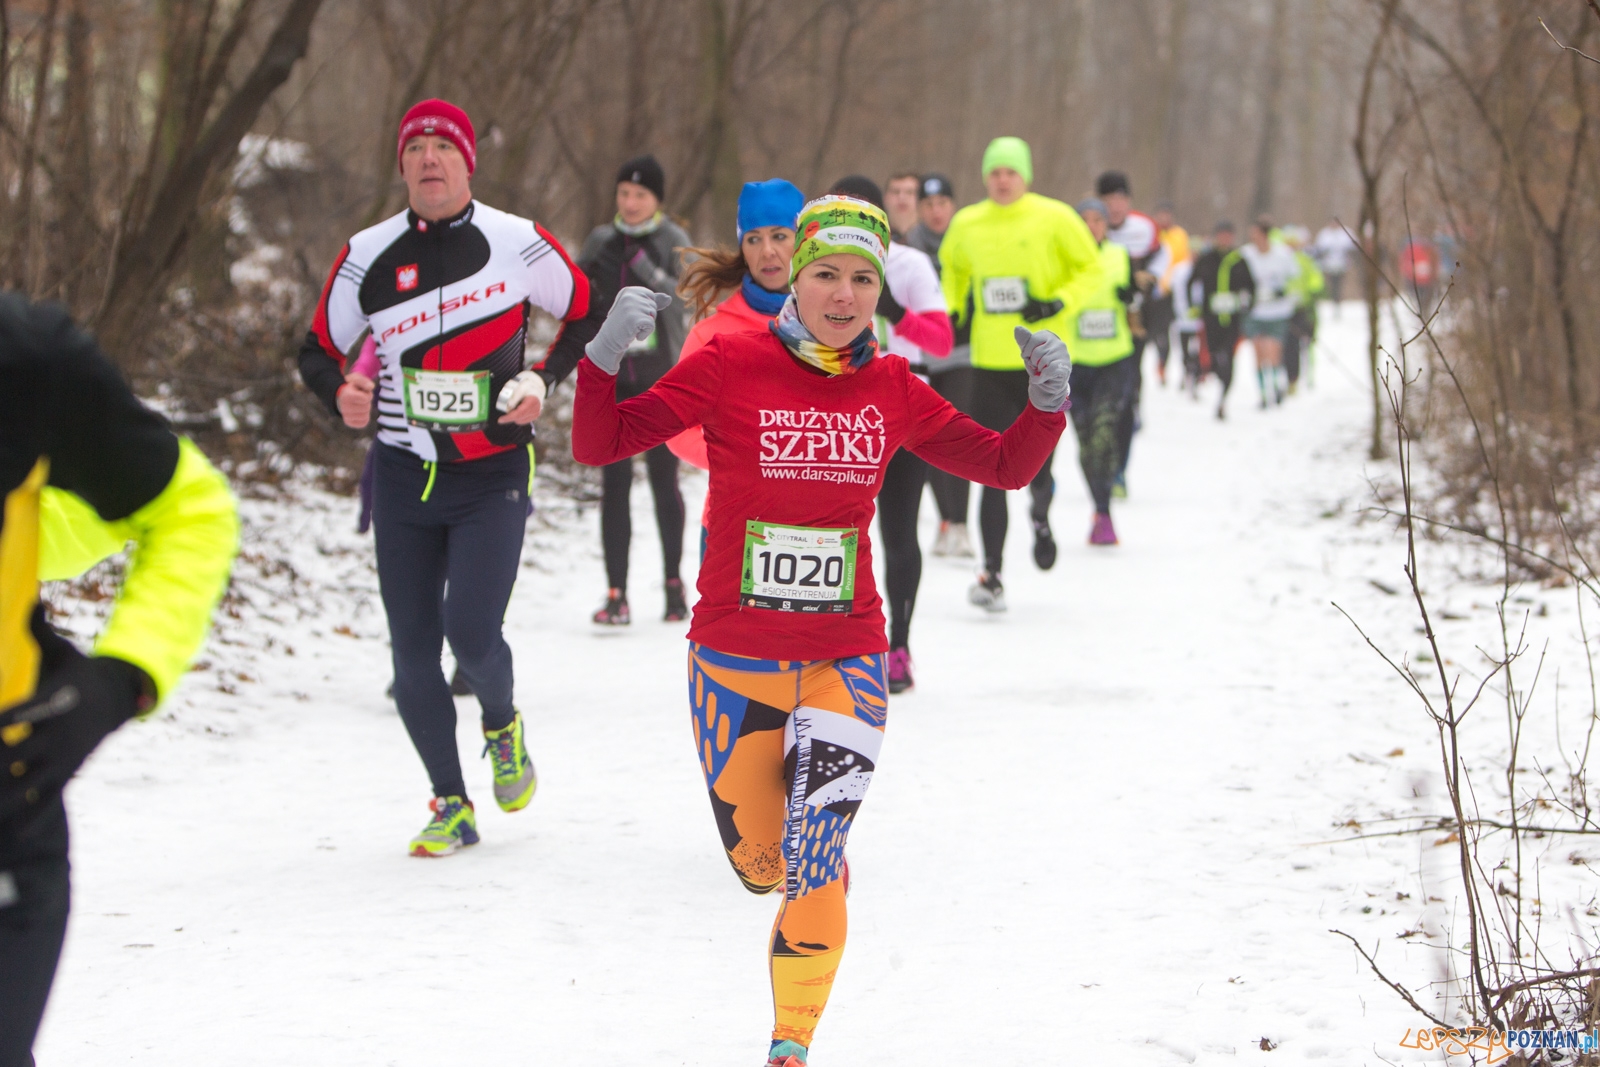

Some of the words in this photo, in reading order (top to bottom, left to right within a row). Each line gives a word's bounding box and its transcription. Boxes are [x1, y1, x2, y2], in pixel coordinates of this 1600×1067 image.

[381, 280, 506, 343] POLSKA
[416, 390, 474, 413] 1925
[758, 407, 868, 432] DRUŻYNA
[759, 430, 886, 464] SZPIKU
[761, 467, 877, 486] www.darszpiku.pl
[759, 551, 843, 587] 1020
